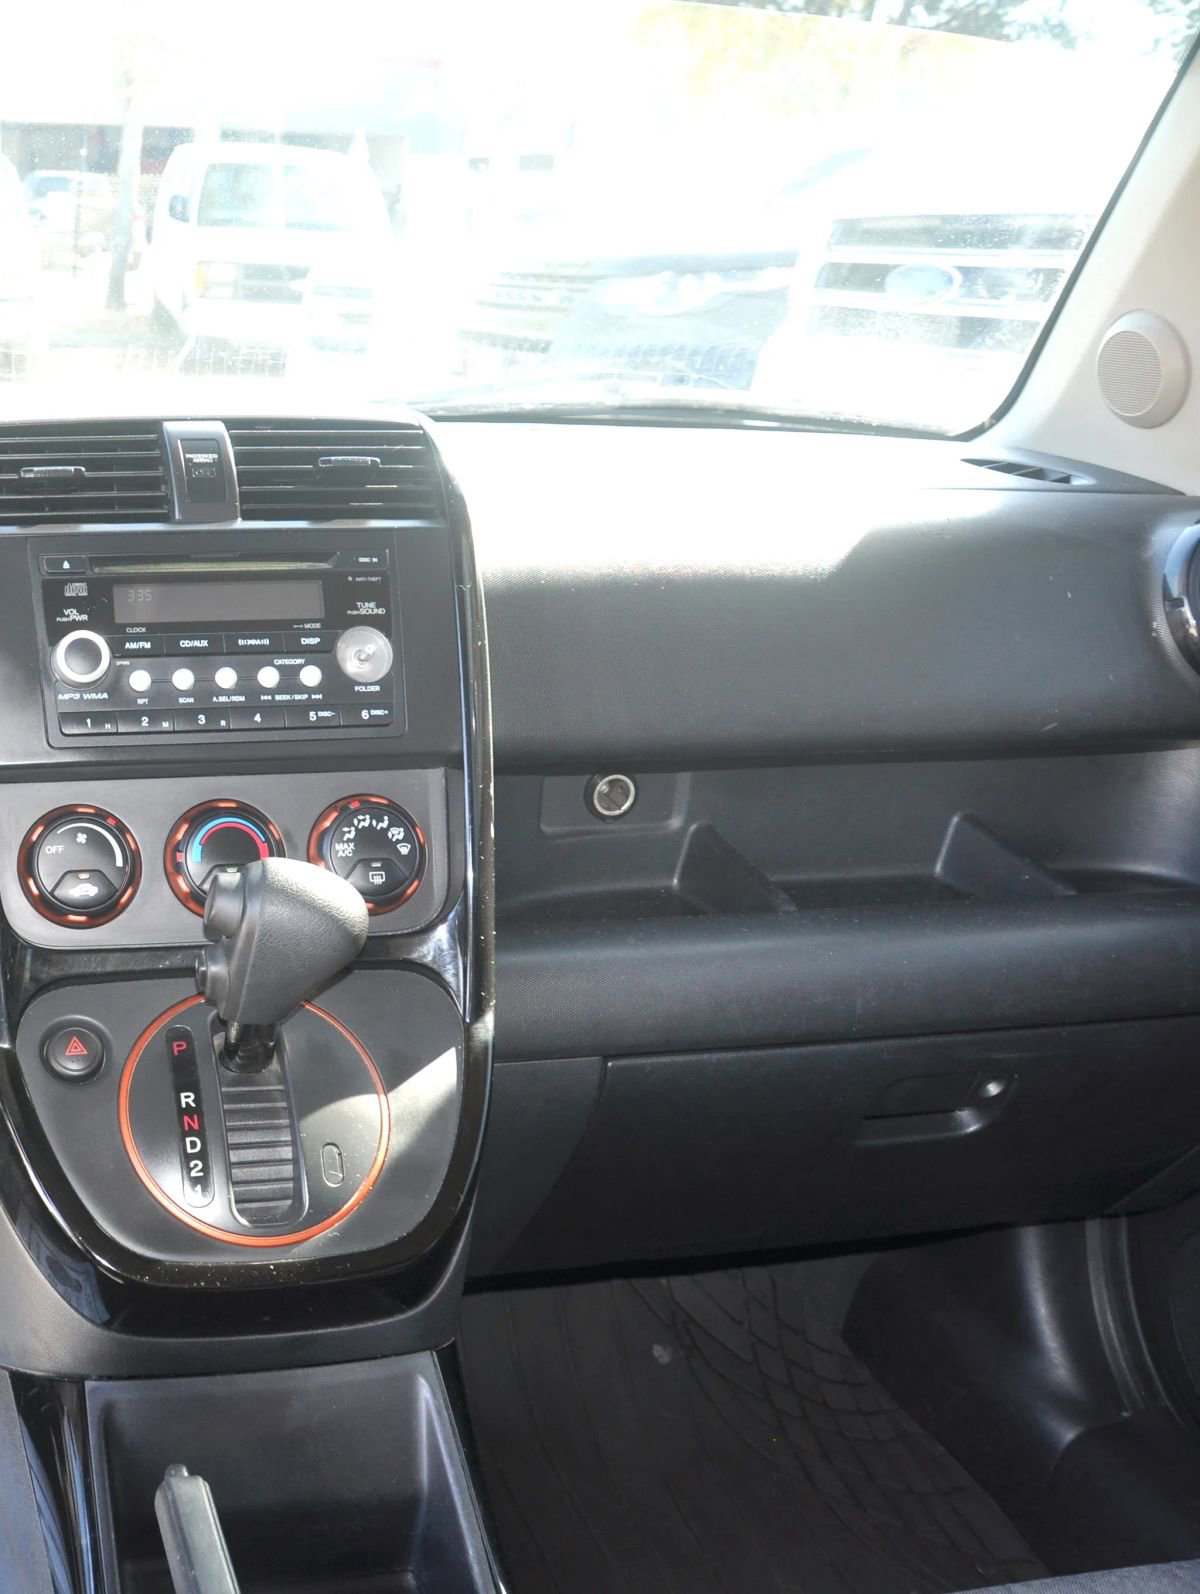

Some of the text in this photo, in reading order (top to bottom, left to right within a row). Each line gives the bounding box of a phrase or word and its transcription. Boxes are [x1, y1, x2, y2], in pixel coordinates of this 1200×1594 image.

[356, 601, 376, 609] TUNE
[63, 608, 80, 616] VOL
[69, 614, 89, 622] PWR
[125, 641, 151, 650] AM/FM
[179, 639, 208, 648] CD/AUX
[273, 658, 305, 666] CATEGORY
[197, 714, 206, 725] 3
[253, 713, 262, 723] 4
[309, 711, 317, 721] 5
[361, 709, 370, 720] 6
[86, 718, 91, 728] 1
[141, 716, 149, 726] 2
[45, 845, 64, 854] OFF
[335, 842, 355, 850] MAX
[172, 1041, 187, 1056] P
[180, 1092, 196, 1108] R
[183, 1114, 199, 1131] N
[185, 1136, 201, 1154] D
[190, 1160, 204, 1177] 2
